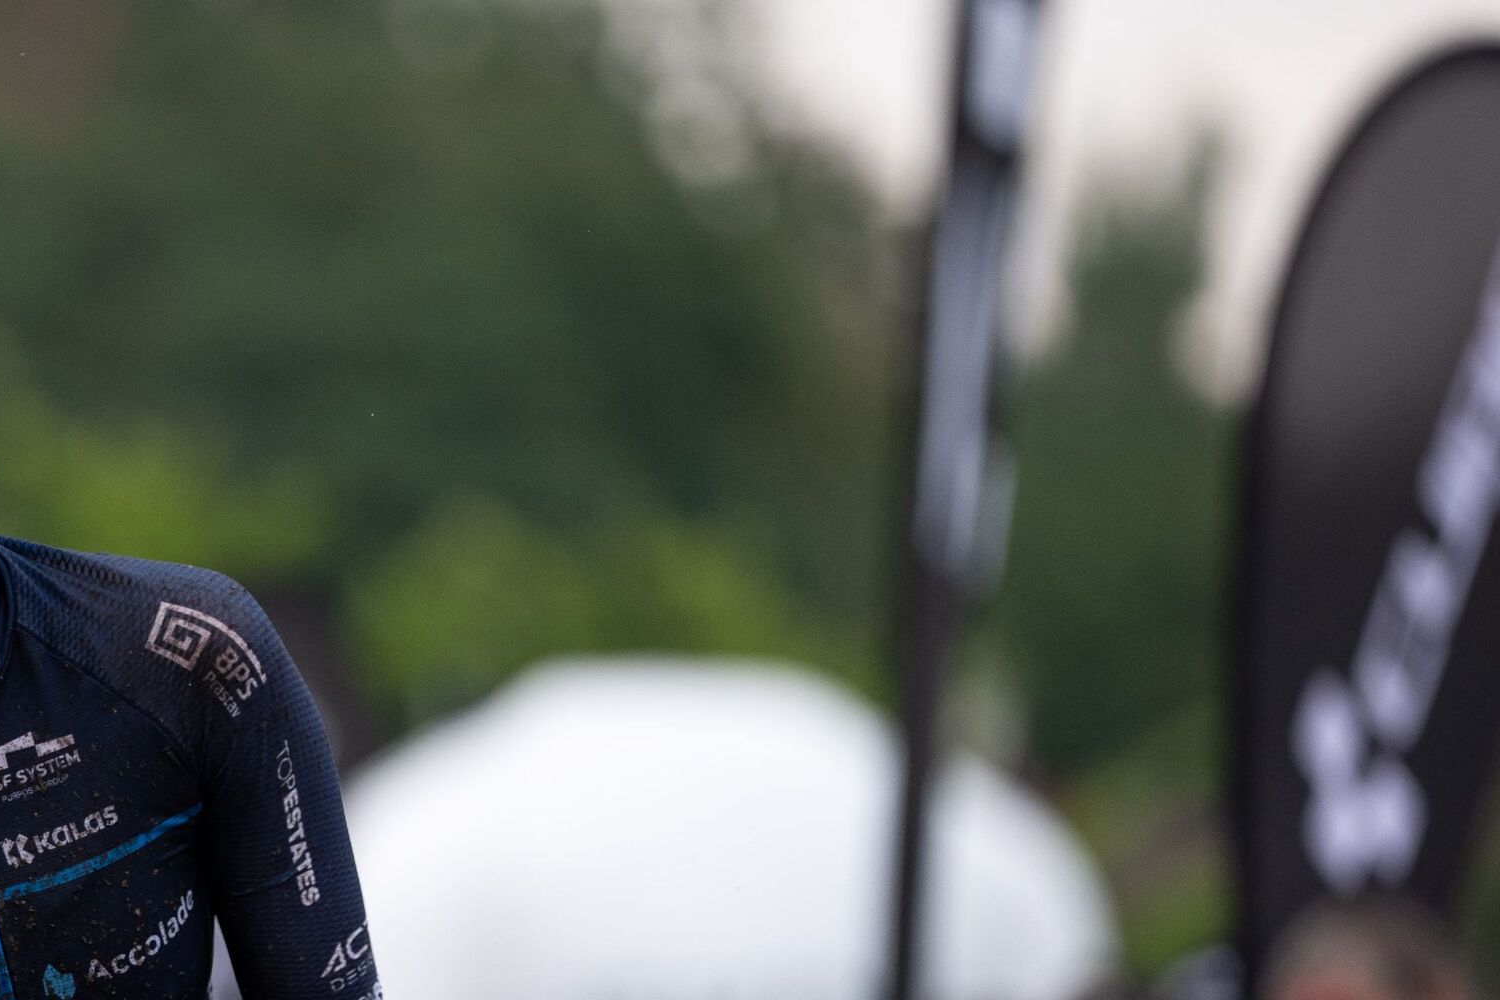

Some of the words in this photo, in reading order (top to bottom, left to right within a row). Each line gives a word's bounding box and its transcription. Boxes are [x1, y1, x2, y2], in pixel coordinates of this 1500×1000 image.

[215, 645, 258, 700] BPS
[15, 749, 82, 785] SYSTEM
[88, 889, 195, 983] Accolade
